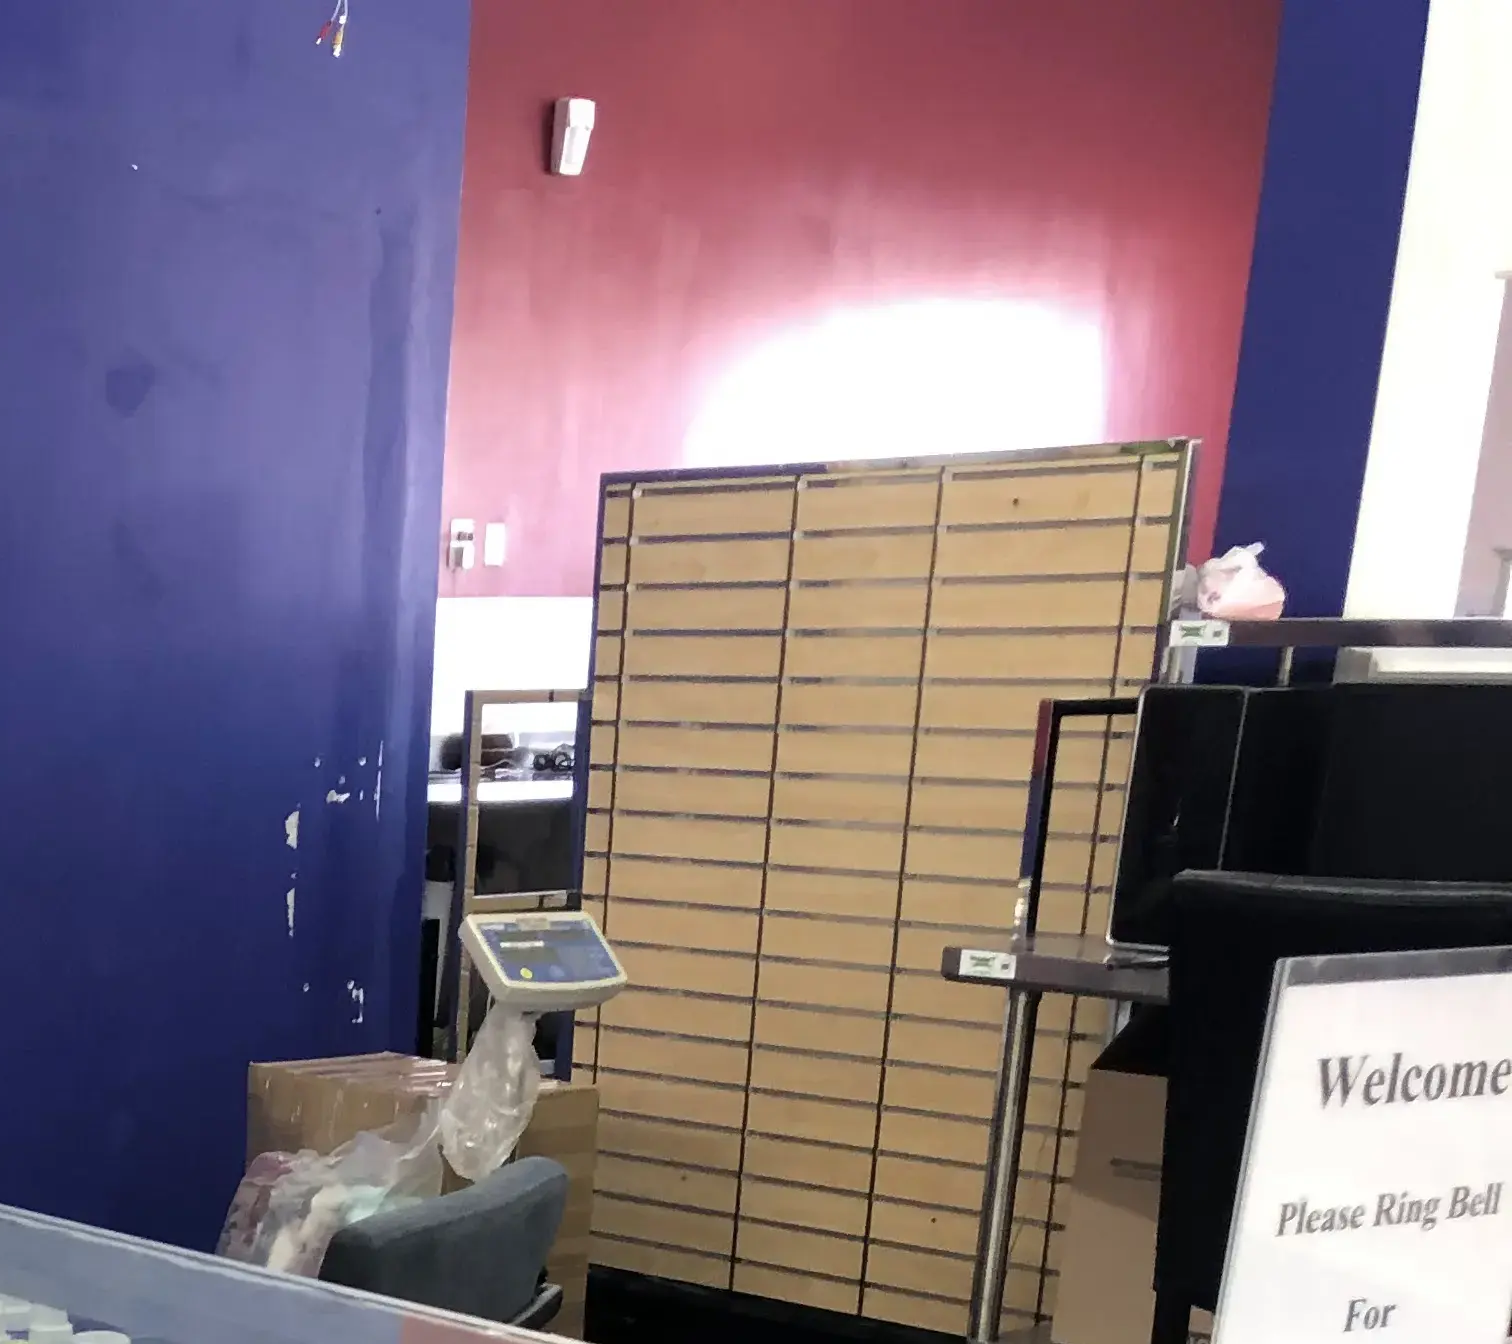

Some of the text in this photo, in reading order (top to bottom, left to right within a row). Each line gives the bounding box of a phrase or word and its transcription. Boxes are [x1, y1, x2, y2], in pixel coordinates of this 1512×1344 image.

[1317, 1052, 1512, 1109] Welcome
[1275, 1181, 1503, 1237] Please Ring Bell
[1343, 1297, 1397, 1333] For
